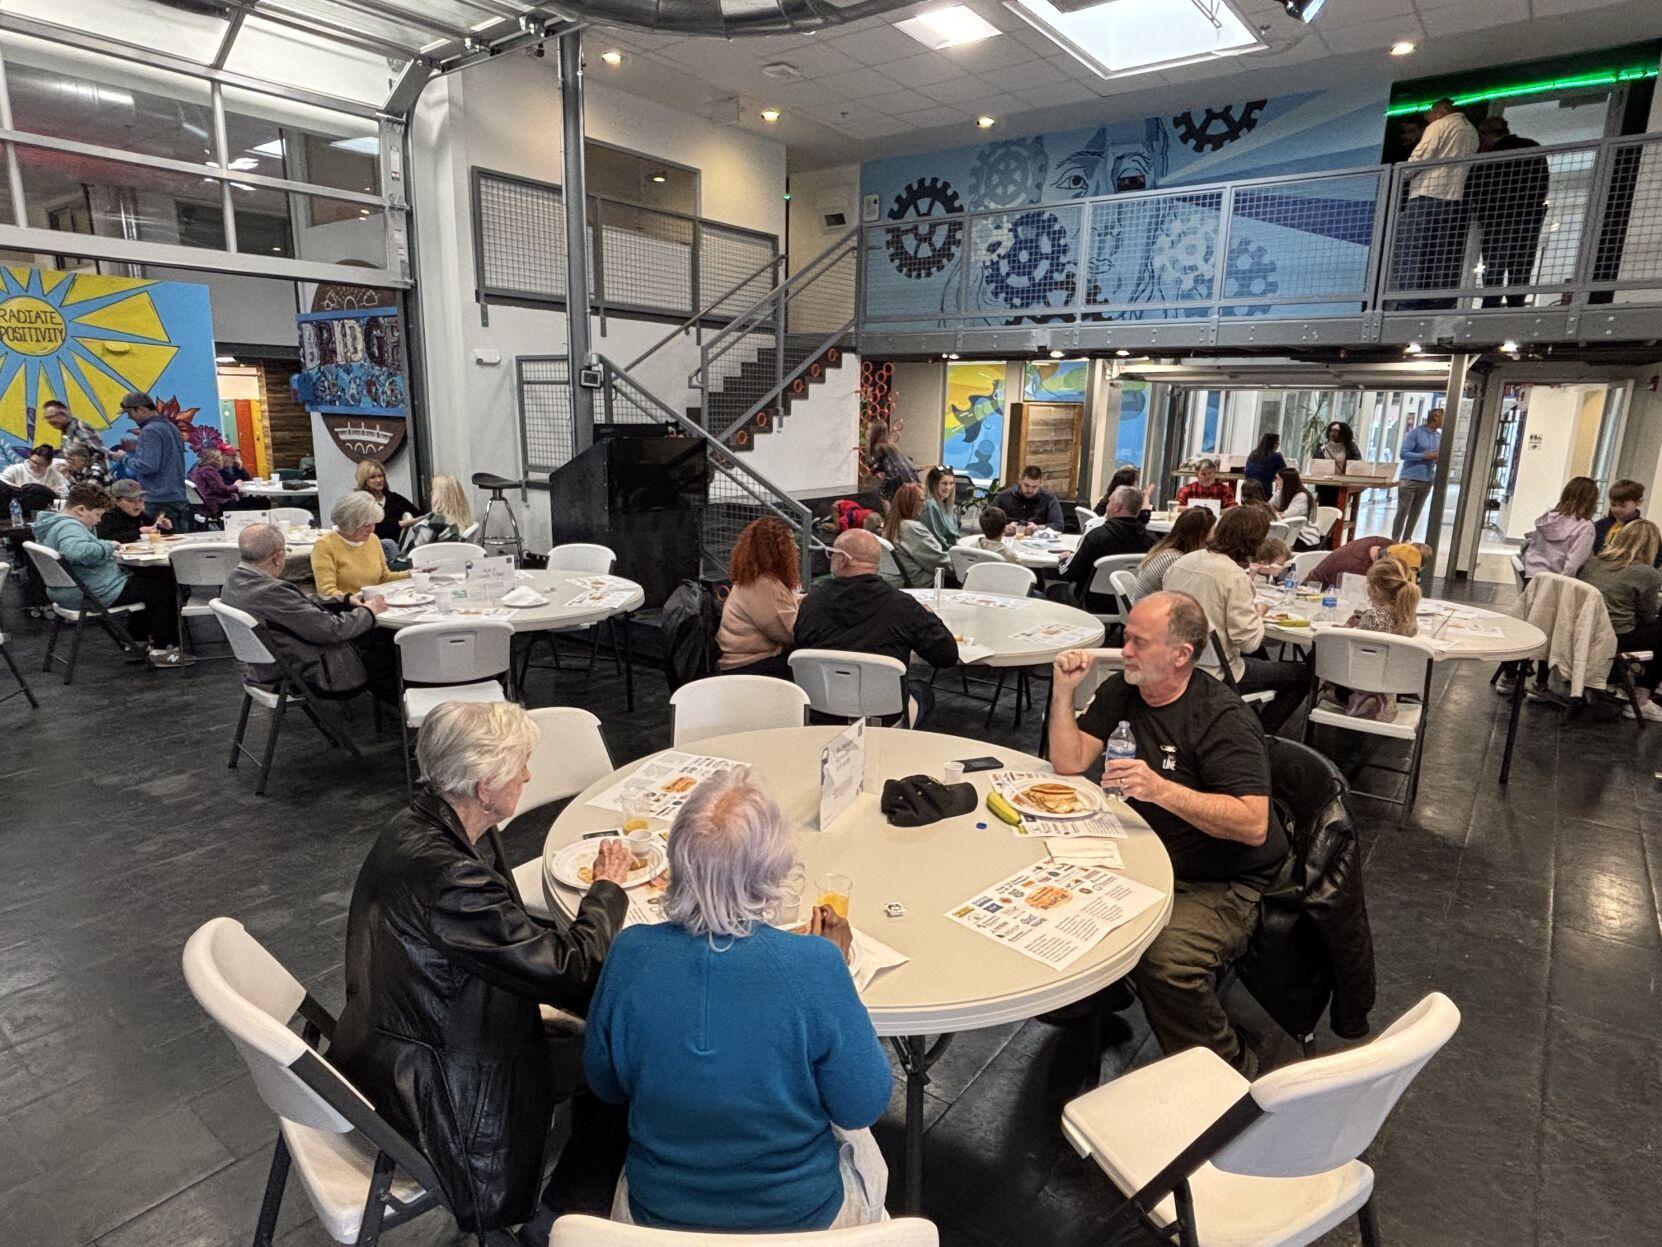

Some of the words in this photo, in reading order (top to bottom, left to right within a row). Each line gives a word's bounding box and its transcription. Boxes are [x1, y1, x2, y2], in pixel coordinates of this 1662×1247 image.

[0, 308, 63, 326] RADIATE
[0, 325, 64, 343] POSITIVITY
[301, 317, 401, 371] BRIDGE
